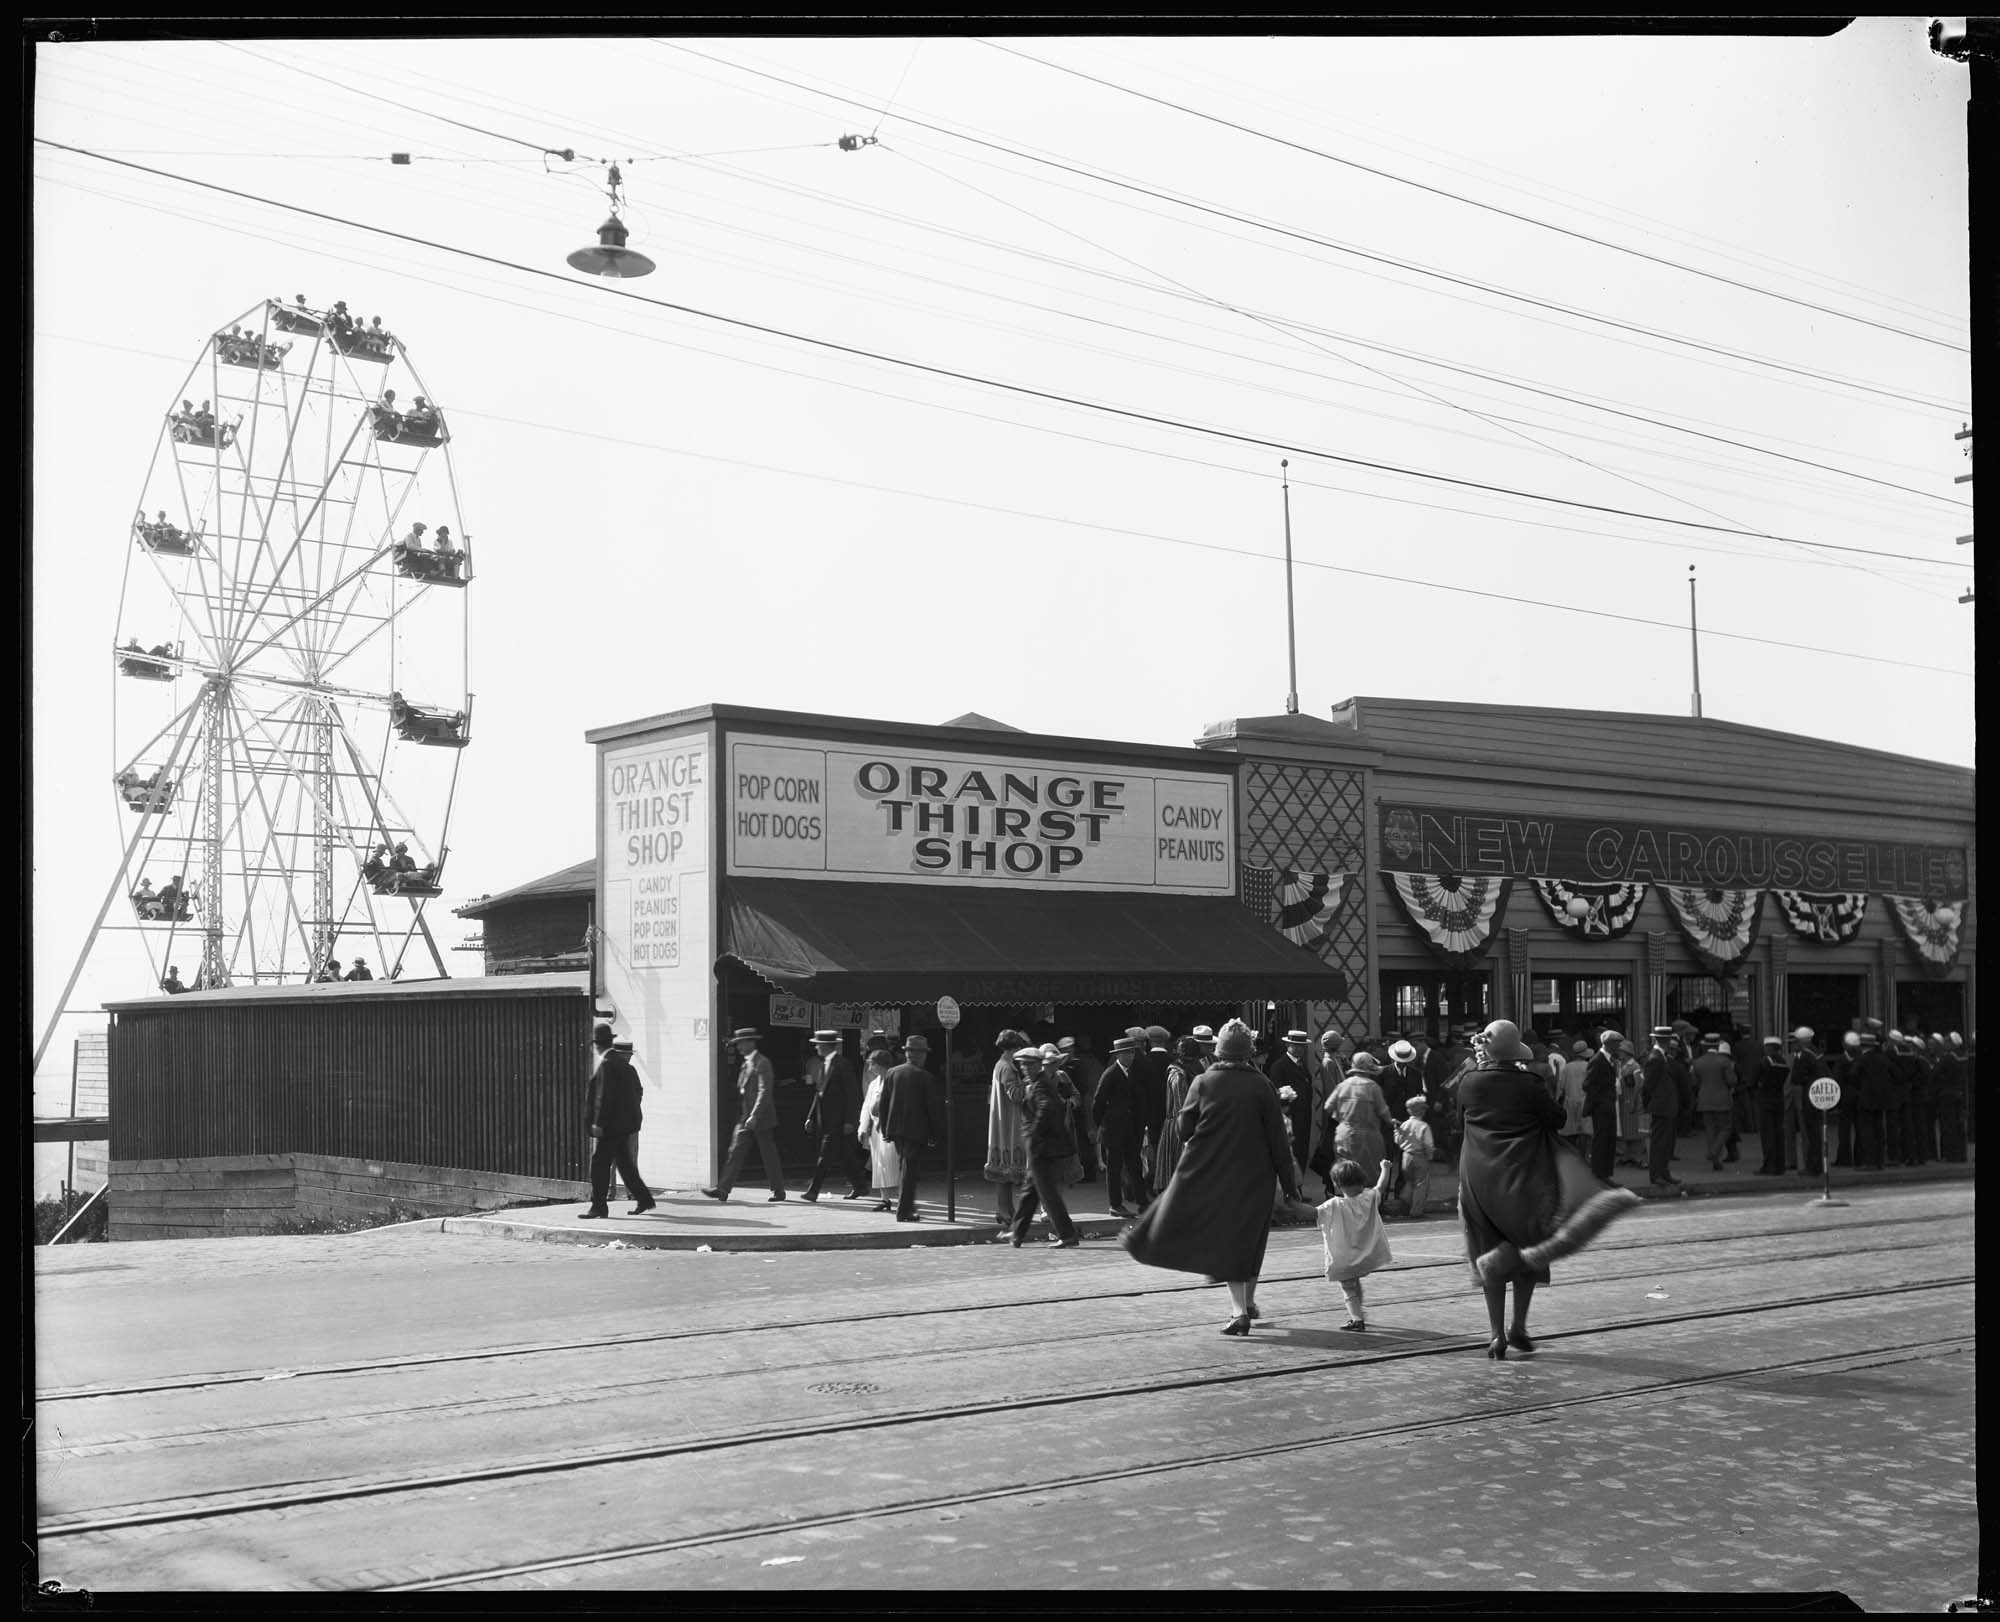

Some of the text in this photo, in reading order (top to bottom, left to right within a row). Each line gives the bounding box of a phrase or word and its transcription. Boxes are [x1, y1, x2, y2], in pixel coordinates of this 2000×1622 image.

[611, 752, 702, 796] ORANGE
[738, 773, 820, 804] POP CORN
[857, 761, 1125, 811] ORANGE
[617, 791, 694, 831] THIRST
[879, 799, 1111, 843] THIRST
[1161, 804, 1224, 831] CANDY
[737, 812, 822, 841] HOT DOGS
[627, 831, 684, 867] SHOP
[914, 837, 1084, 876] SHOP
[1158, 838, 1225, 863] PEANUTS
[1421, 814, 1946, 896] NEW CAROUSSELLE
[638, 874, 674, 894] CANDY
[633, 896, 679, 917] PEANUTS
[633, 919, 678, 939] POP CORN
[633, 940, 678, 960] HOT DOGS
[1811, 1082, 1839, 1095] SAFETY
